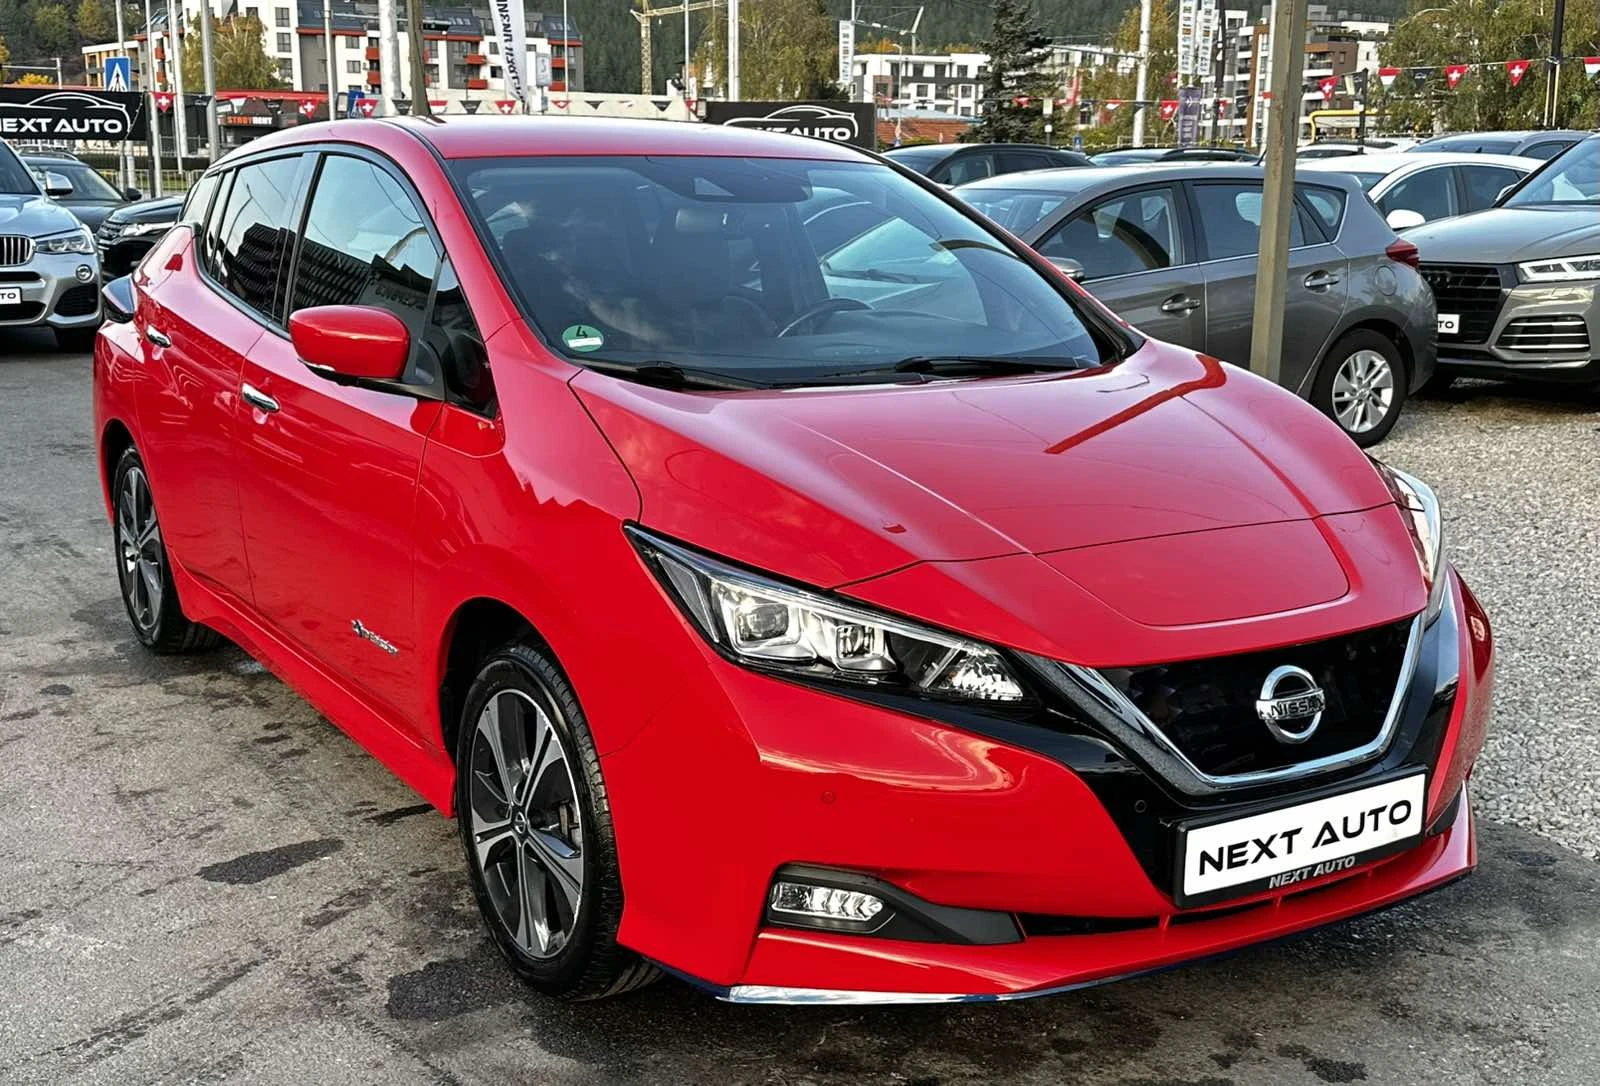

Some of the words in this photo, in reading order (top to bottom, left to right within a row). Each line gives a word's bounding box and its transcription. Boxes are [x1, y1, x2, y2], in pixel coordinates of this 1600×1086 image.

[0, 118, 52, 132] EXT
[54, 118, 122, 133] AUTO
[576, 326, 588, 338] 4
[1199, 827, 1302, 876] NEXT
[1312, 799, 1412, 849] AUTO
[1268, 866, 1311, 889] NEXT
[1313, 856, 1355, 877] AUTO
